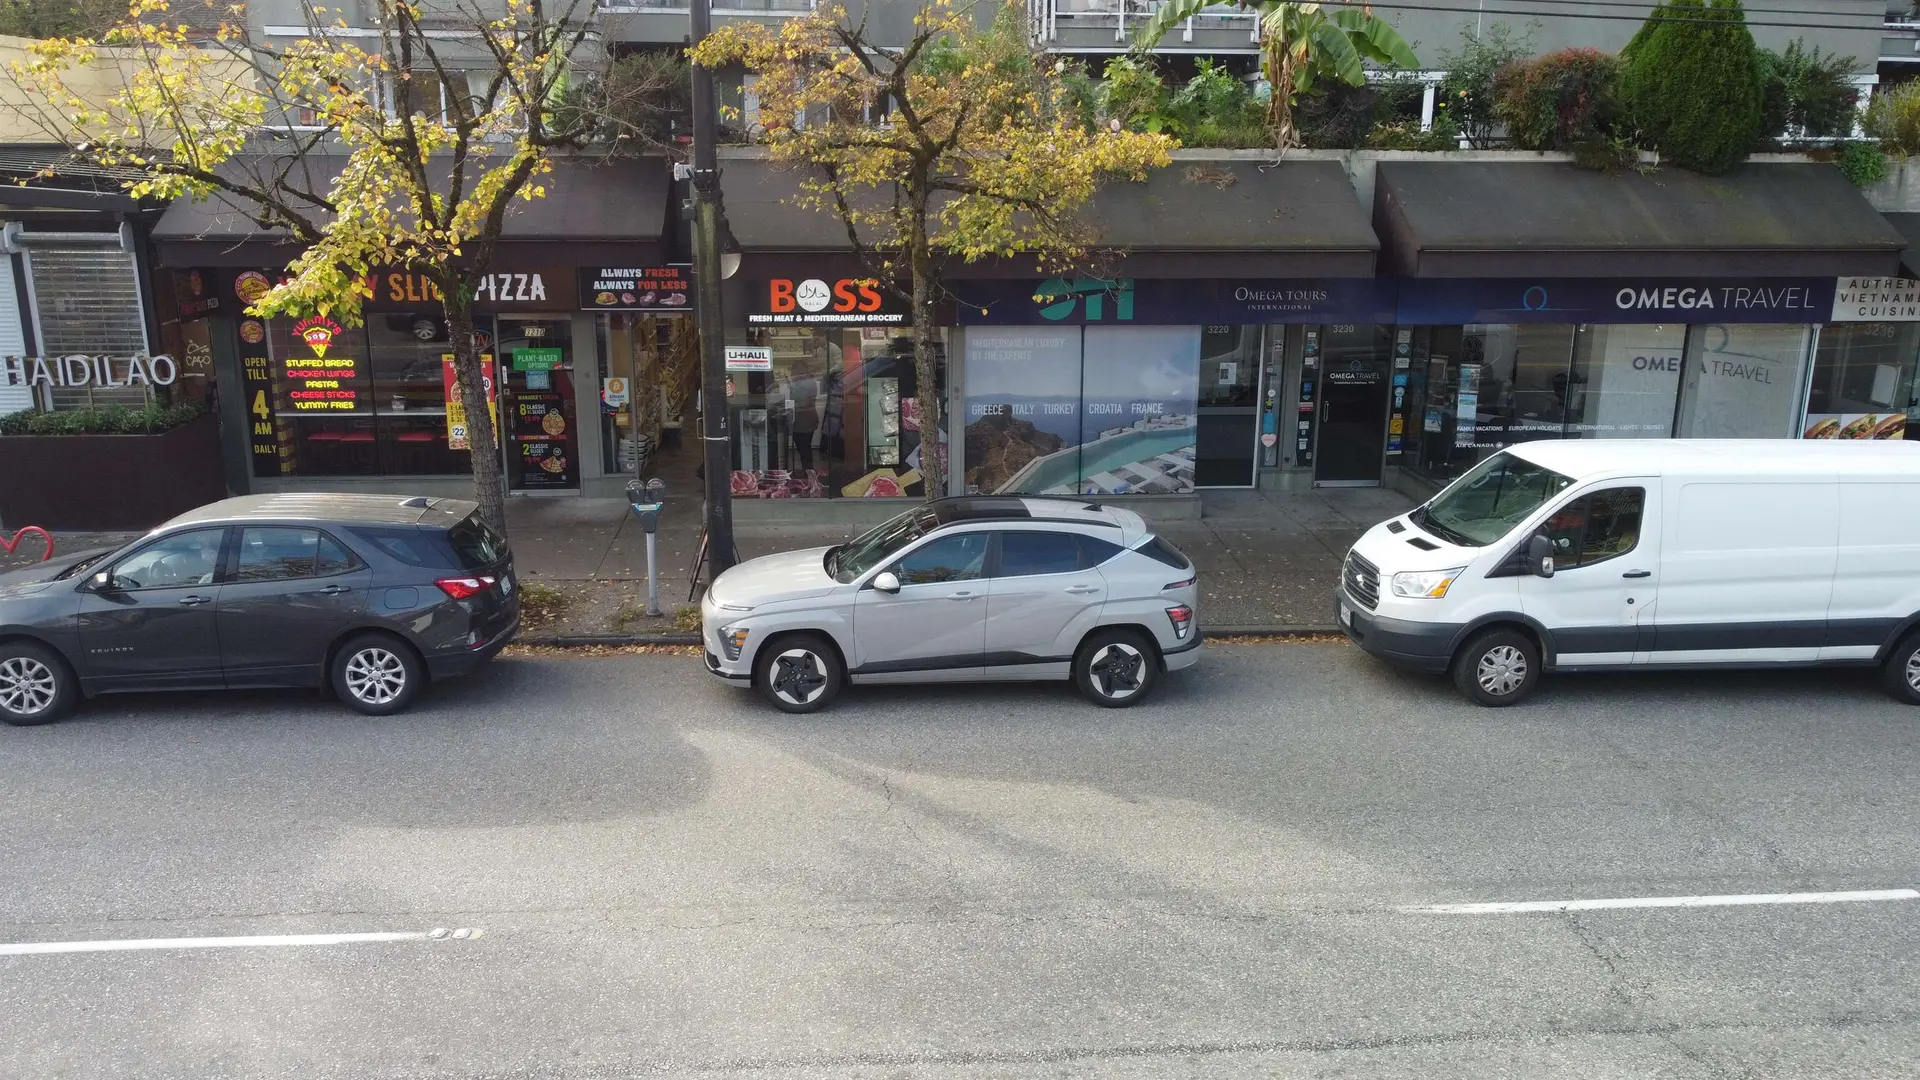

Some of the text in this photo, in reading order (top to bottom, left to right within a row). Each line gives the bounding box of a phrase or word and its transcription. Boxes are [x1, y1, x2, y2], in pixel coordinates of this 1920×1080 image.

[601, 269, 679, 277] ALWAYS FRESH
[593, 281, 688, 290] ALWAYS FOR LESS
[1235, 287, 1328, 301] OMEGA TOURS
[1616, 288, 1815, 309] OMEGA TRAVEL
[1858, 307, 1920, 316] CUISIN
[867, 314, 903, 322] GROCERY
[526, 328, 545, 336] 3210
[1207, 325, 1229, 334] 3220
[1333, 325, 1354, 333] 3230
[972, 338, 1065, 348] MEDITERRANEAN LUXURY
[728, 351, 767, 360] U-HAUL
[972, 351, 1032, 360] BY THE EXPERTS
[245, 358, 266, 367] OPEN
[3, 355, 176, 387] HAIDILAO
[247, 369, 267, 380] TILL
[1712, 360, 1772, 385] TRAVEL
[253, 389, 269, 419] 4
[331, 401, 354, 409] FRIES
[972, 403, 1163, 414] GREECE ITALY TURKEY CROATIA FRANCE
[520, 404, 526, 415] 8
[254, 422, 272, 435] AM
[254, 444, 276, 454] DAILY
[523, 444, 529, 455] 2
